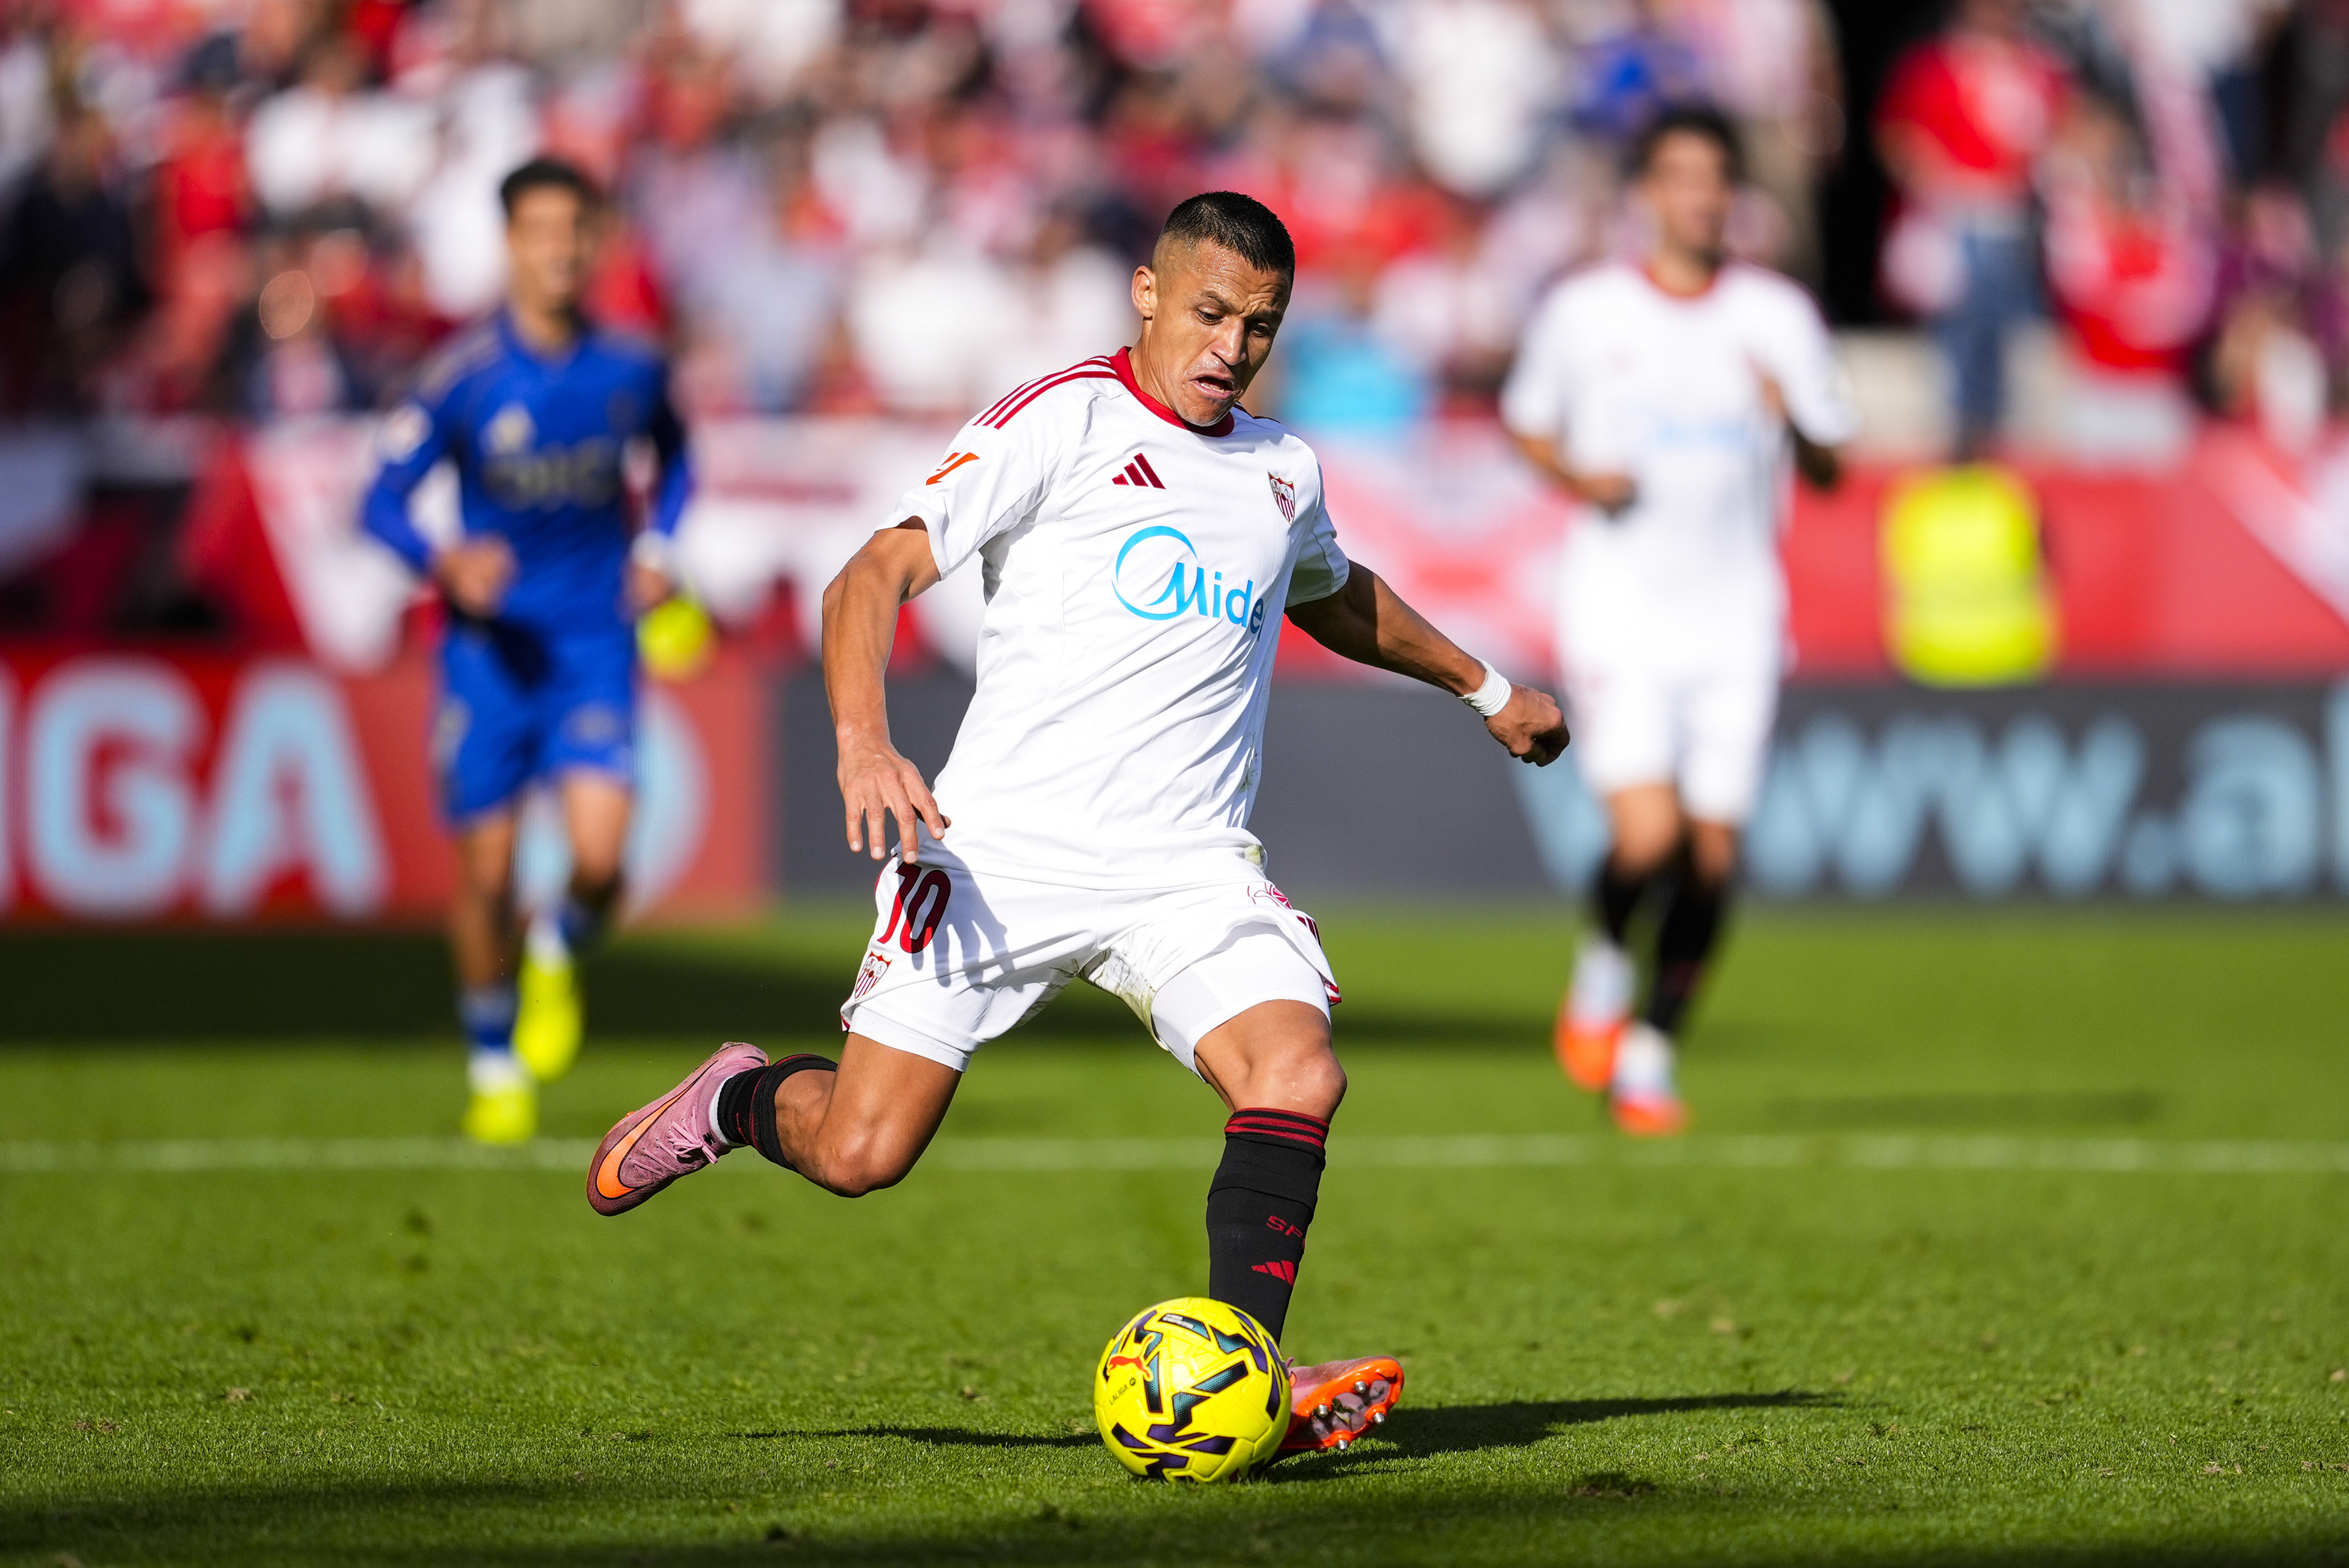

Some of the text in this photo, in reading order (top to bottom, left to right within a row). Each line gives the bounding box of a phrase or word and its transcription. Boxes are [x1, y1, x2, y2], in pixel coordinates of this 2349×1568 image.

[1111, 525, 1265, 642] Mide
[0, 662, 390, 910] GA
[877, 861, 950, 953] 10
[1266, 1216, 1305, 1250] SF
